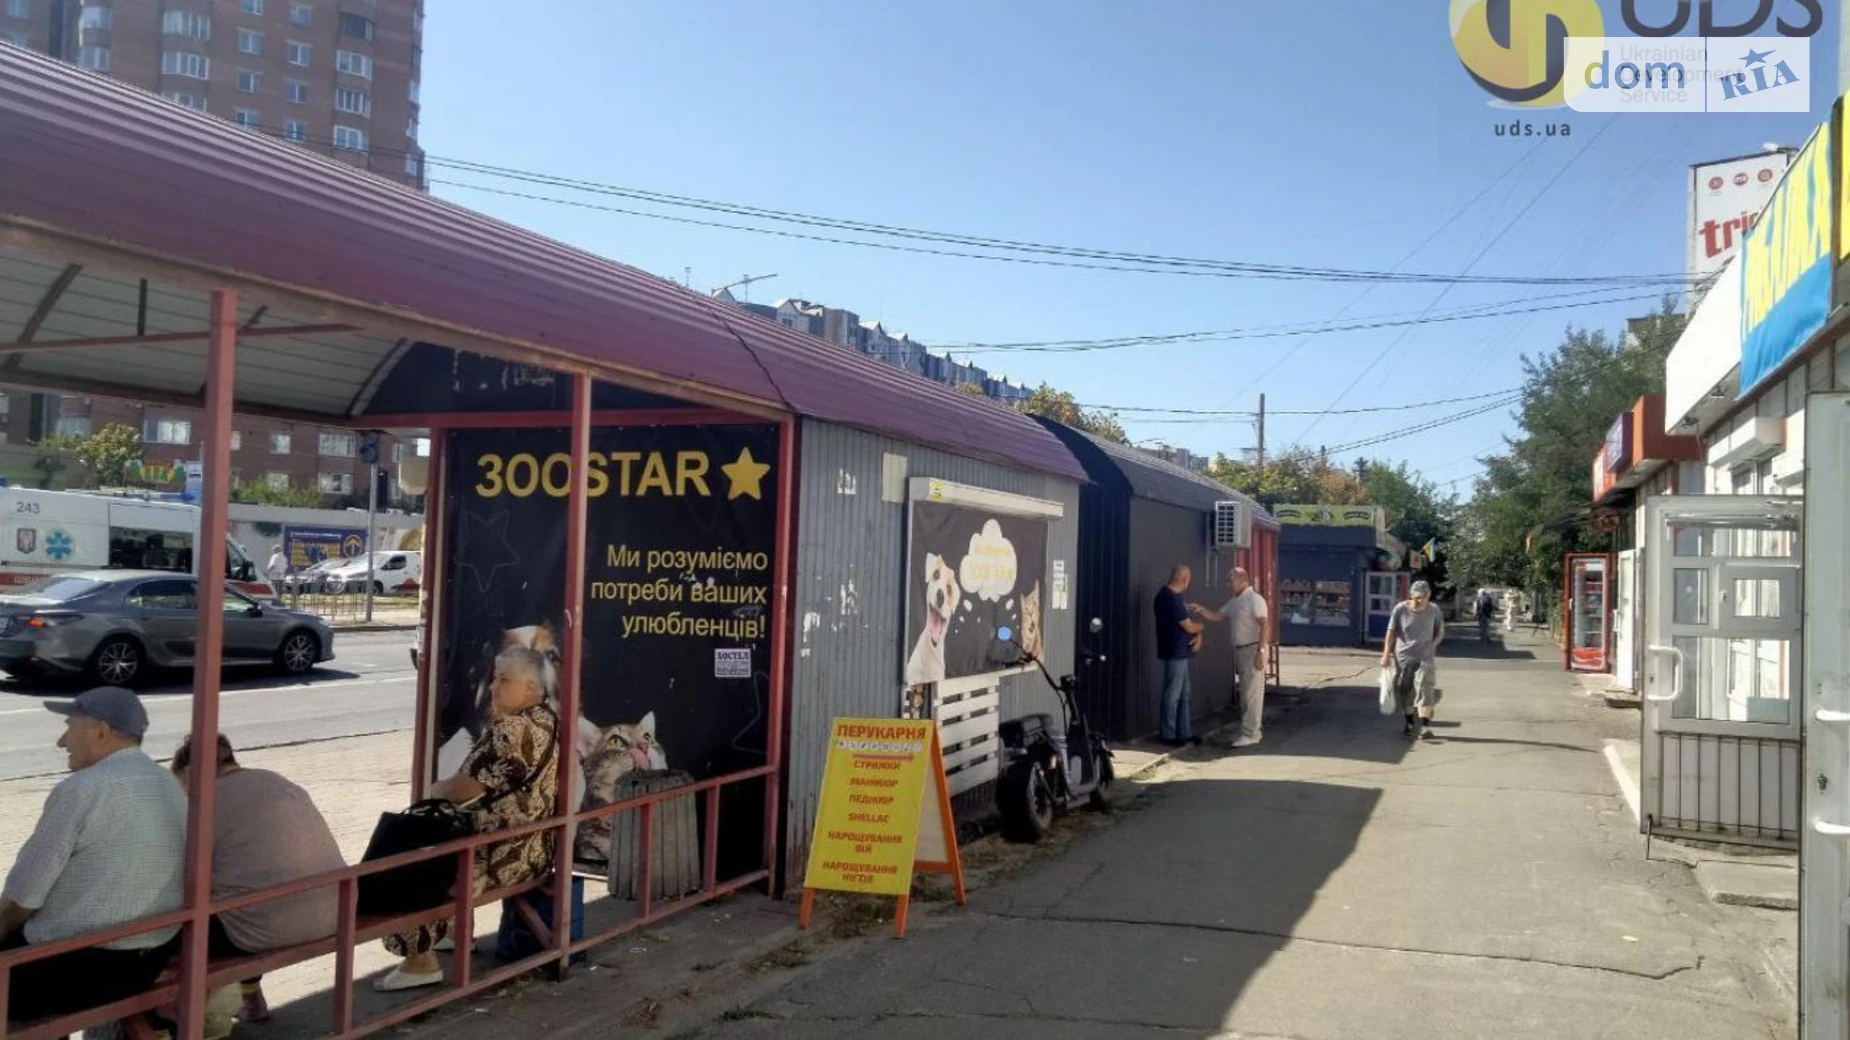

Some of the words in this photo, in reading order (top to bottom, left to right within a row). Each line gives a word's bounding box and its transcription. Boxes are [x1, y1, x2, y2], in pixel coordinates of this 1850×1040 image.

[1699, 211, 1758, 258] tri
[16, 501, 41, 514] 243
[606, 544, 641, 568] Ми
[647, 547, 768, 574] розуміємо
[590, 577, 683, 605] потреби
[691, 582, 767, 605] ваших
[621, 613, 766, 641] улюбленців!
[837, 725, 926, 739] ПЕРУКАРНЯ
[847, 812, 889, 823] SHELLAC
